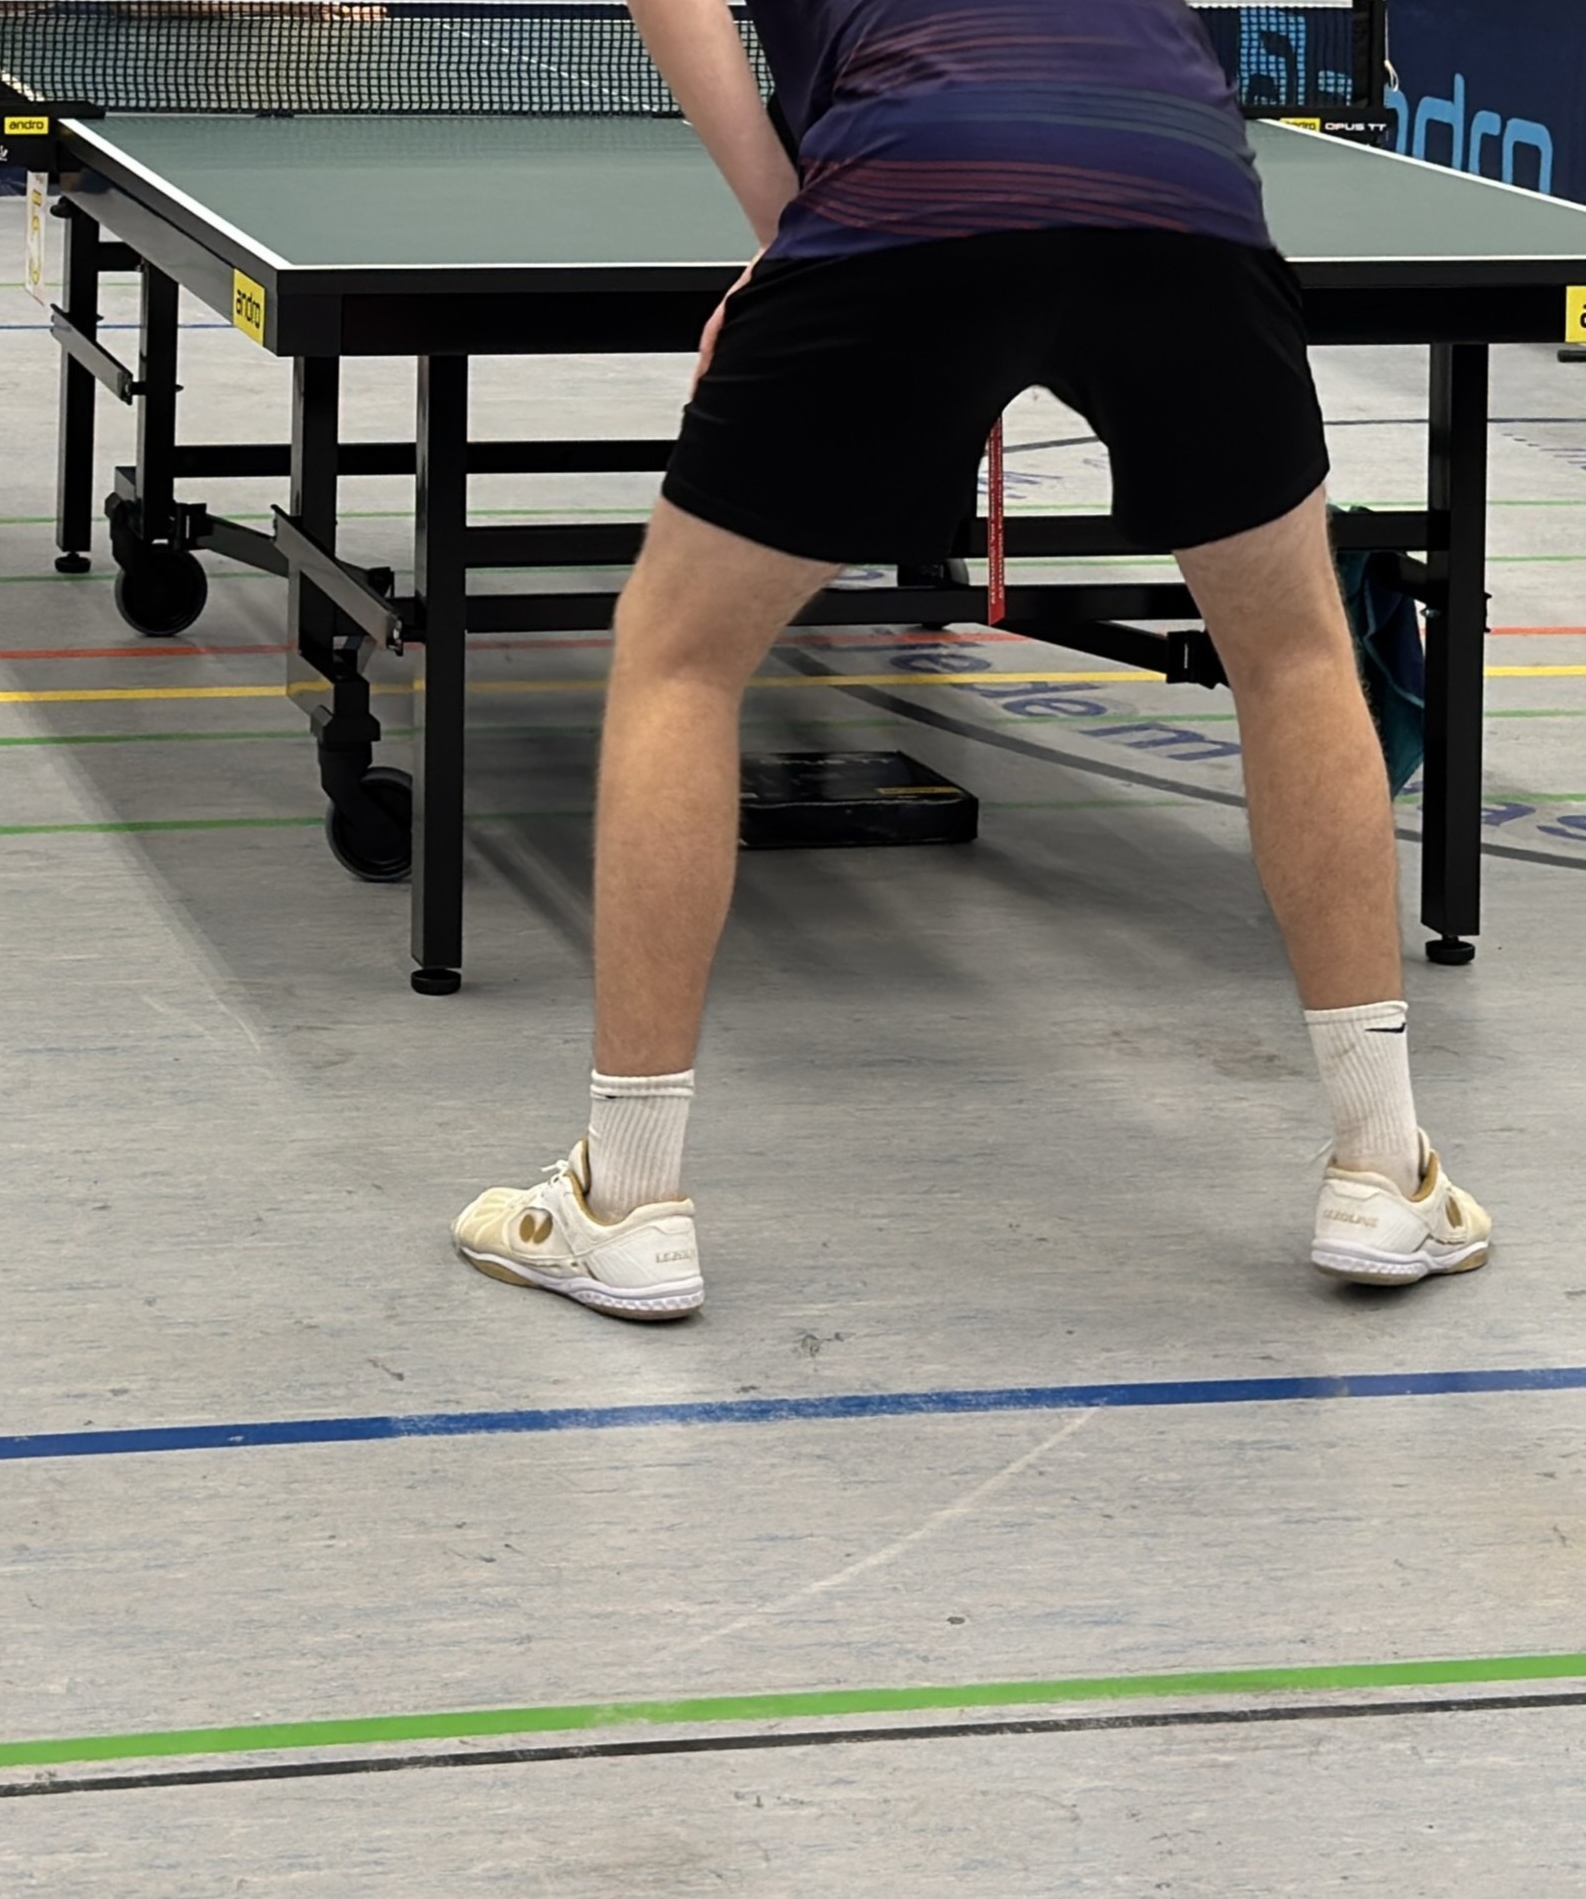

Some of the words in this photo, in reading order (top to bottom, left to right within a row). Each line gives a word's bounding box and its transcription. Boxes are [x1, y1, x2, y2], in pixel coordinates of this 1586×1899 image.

[9, 119, 45, 131] andro
[1324, 122, 1365, 132] OPUS
[1366, 122, 1387, 132] TT
[236, 288, 261, 329] andro
